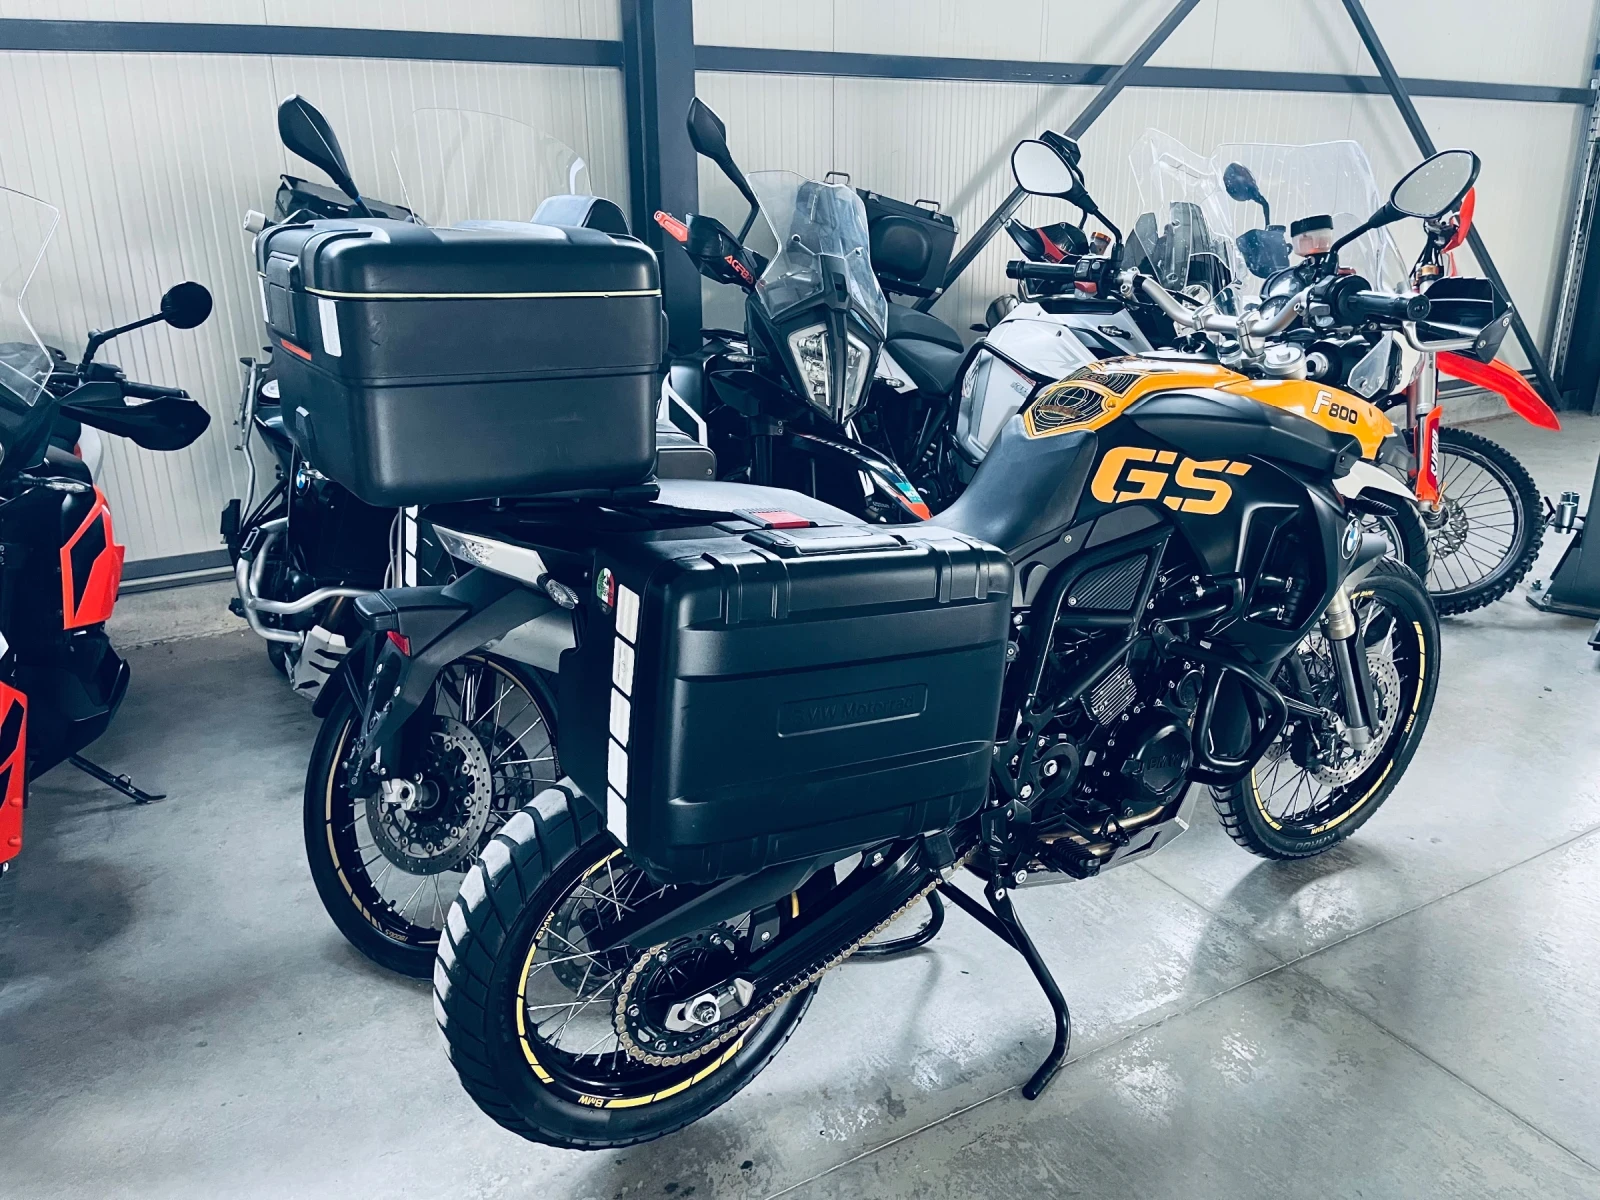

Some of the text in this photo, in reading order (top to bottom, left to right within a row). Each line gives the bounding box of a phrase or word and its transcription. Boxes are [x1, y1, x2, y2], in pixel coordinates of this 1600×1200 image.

[1090, 445, 1253, 516] GS
[1294, 832, 1336, 851] KAROO
[534, 911, 556, 941] BMW
[577, 1094, 605, 1108] BMW
